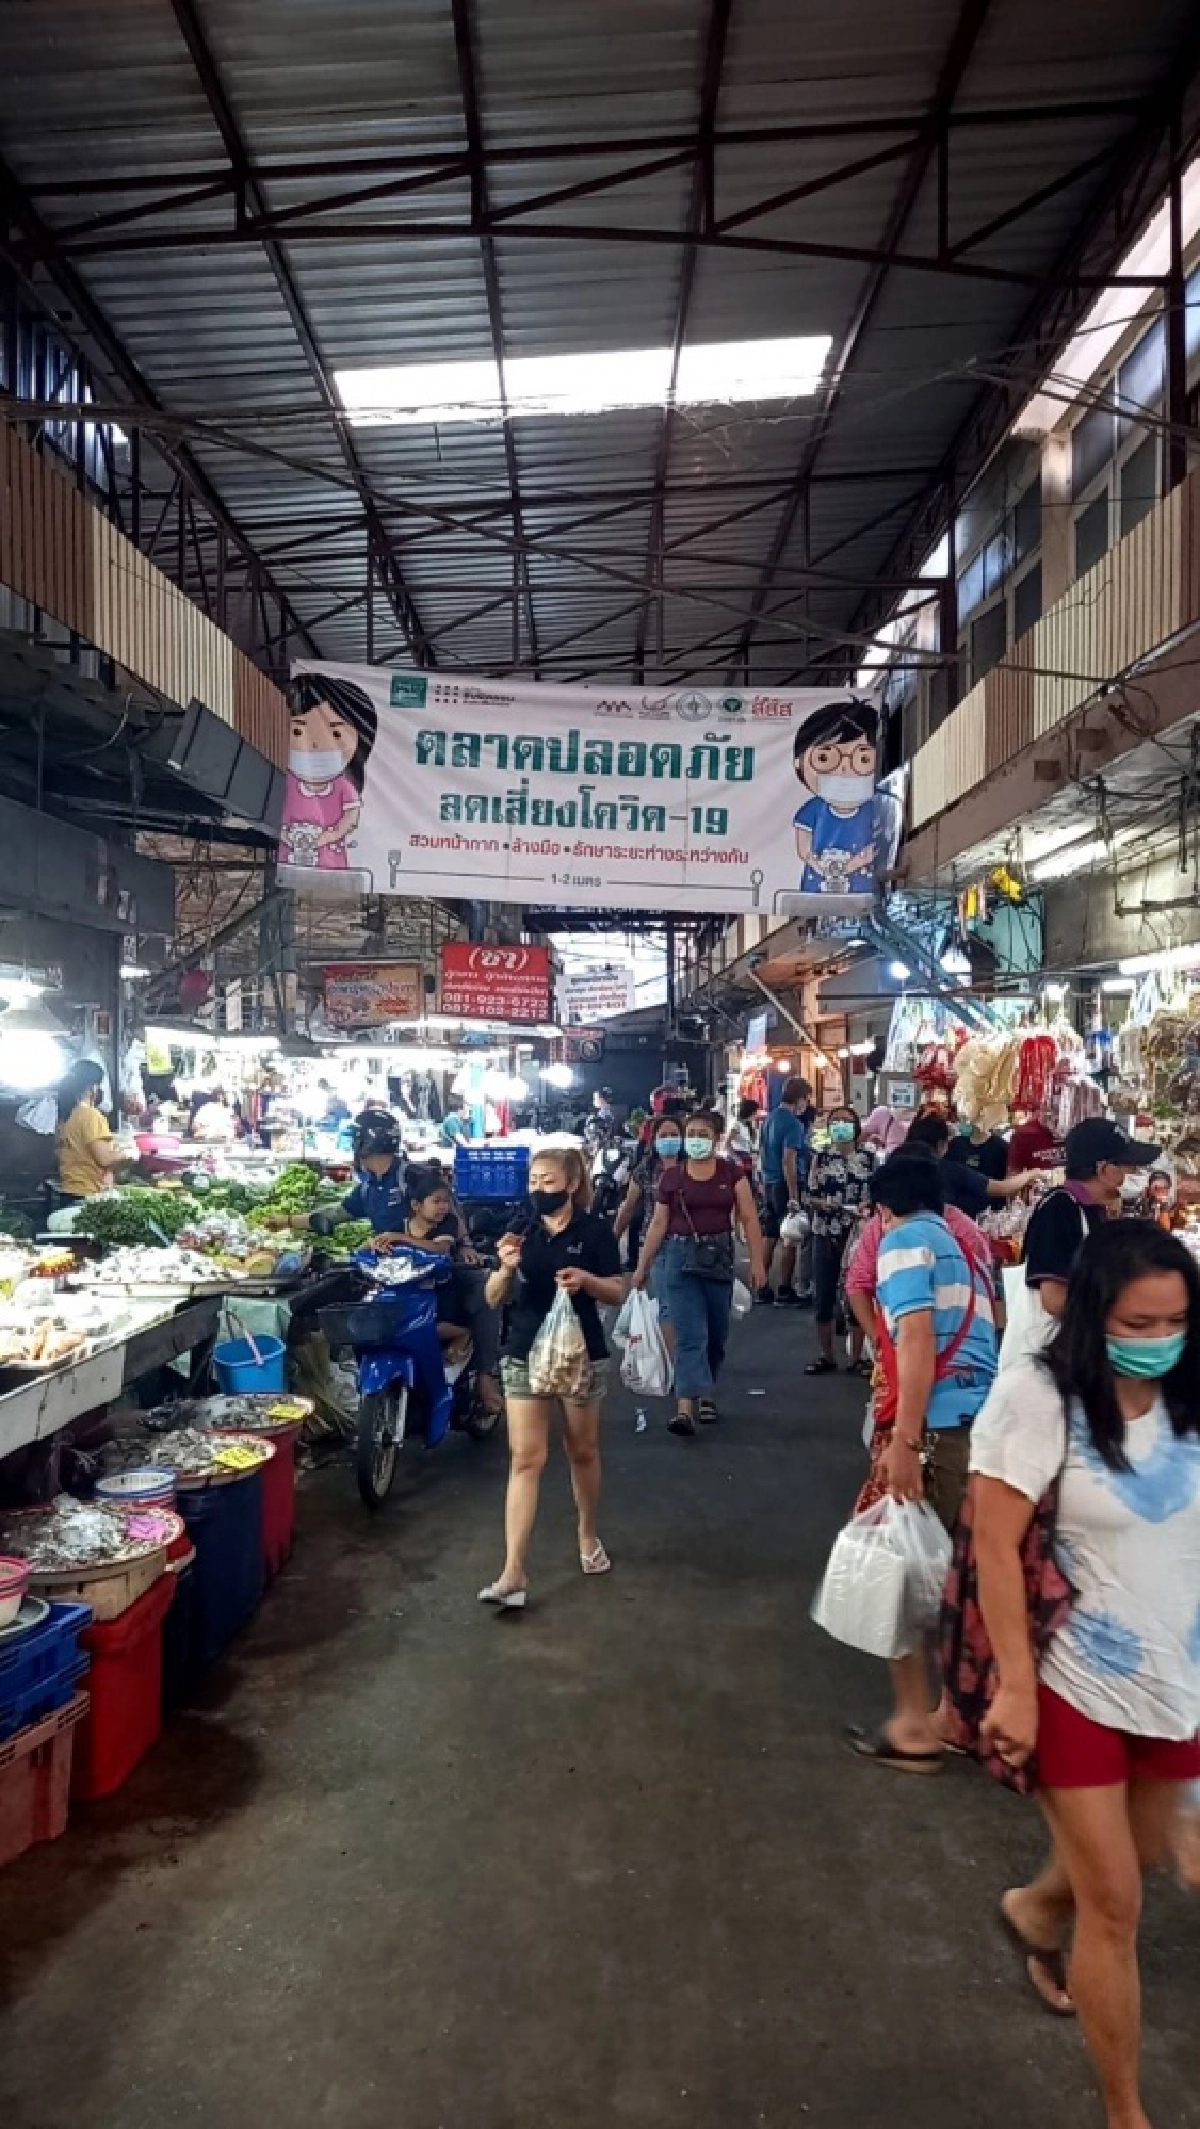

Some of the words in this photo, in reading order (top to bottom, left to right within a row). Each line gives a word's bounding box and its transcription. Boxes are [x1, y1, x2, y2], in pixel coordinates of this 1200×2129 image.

[415, 729, 755, 781] ตลาดปลอดภัย
[409, 833, 499, 851] สวมหน้ากาก
[512, 838, 561, 855] ล้างมือ
[572, 840, 749, 863] รักษาระยะห่างระหว่างกัน
